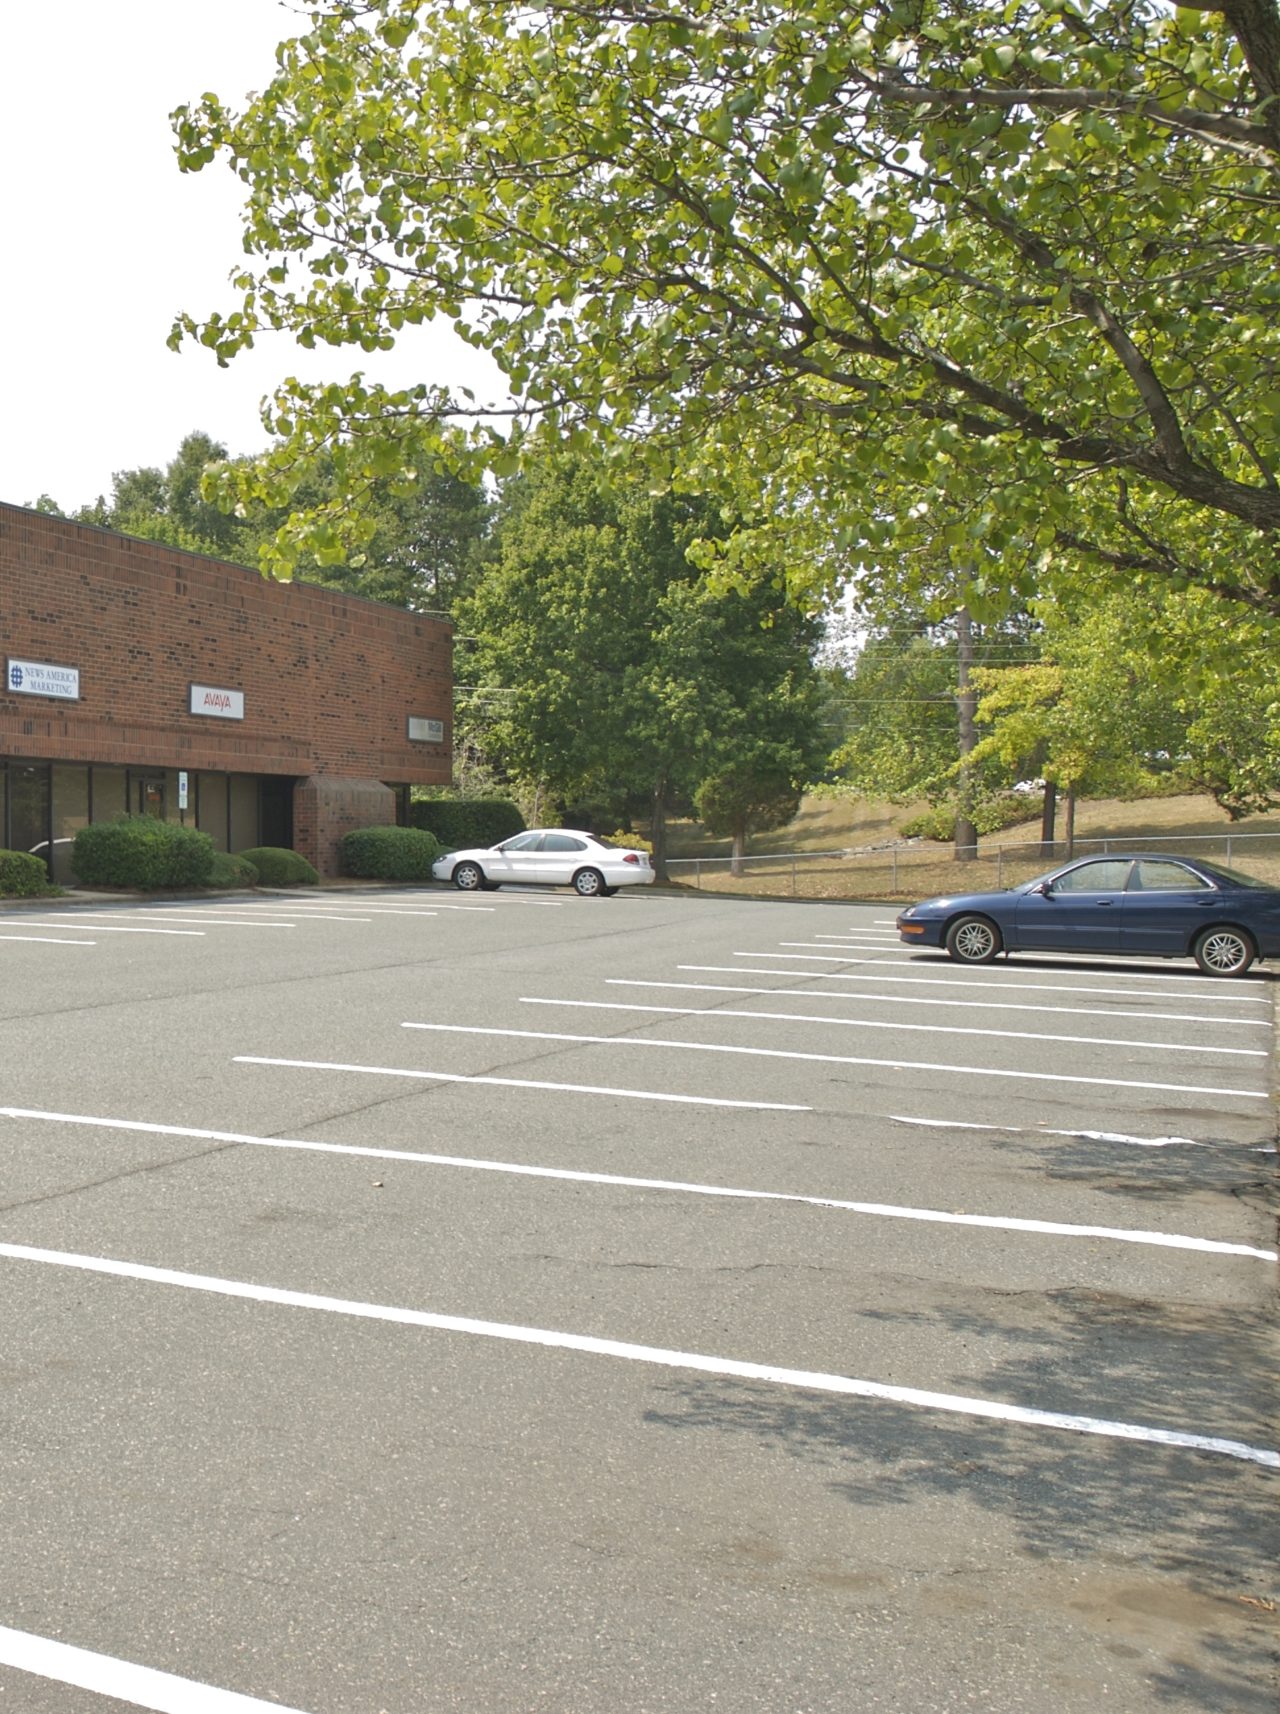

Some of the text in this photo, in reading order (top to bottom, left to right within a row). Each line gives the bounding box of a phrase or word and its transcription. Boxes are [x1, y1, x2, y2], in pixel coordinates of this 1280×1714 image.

[25, 667, 77, 684] NEWS AMERICA
[30, 681, 72, 695] MARKETING
[204, 692, 231, 712] AVAYA
